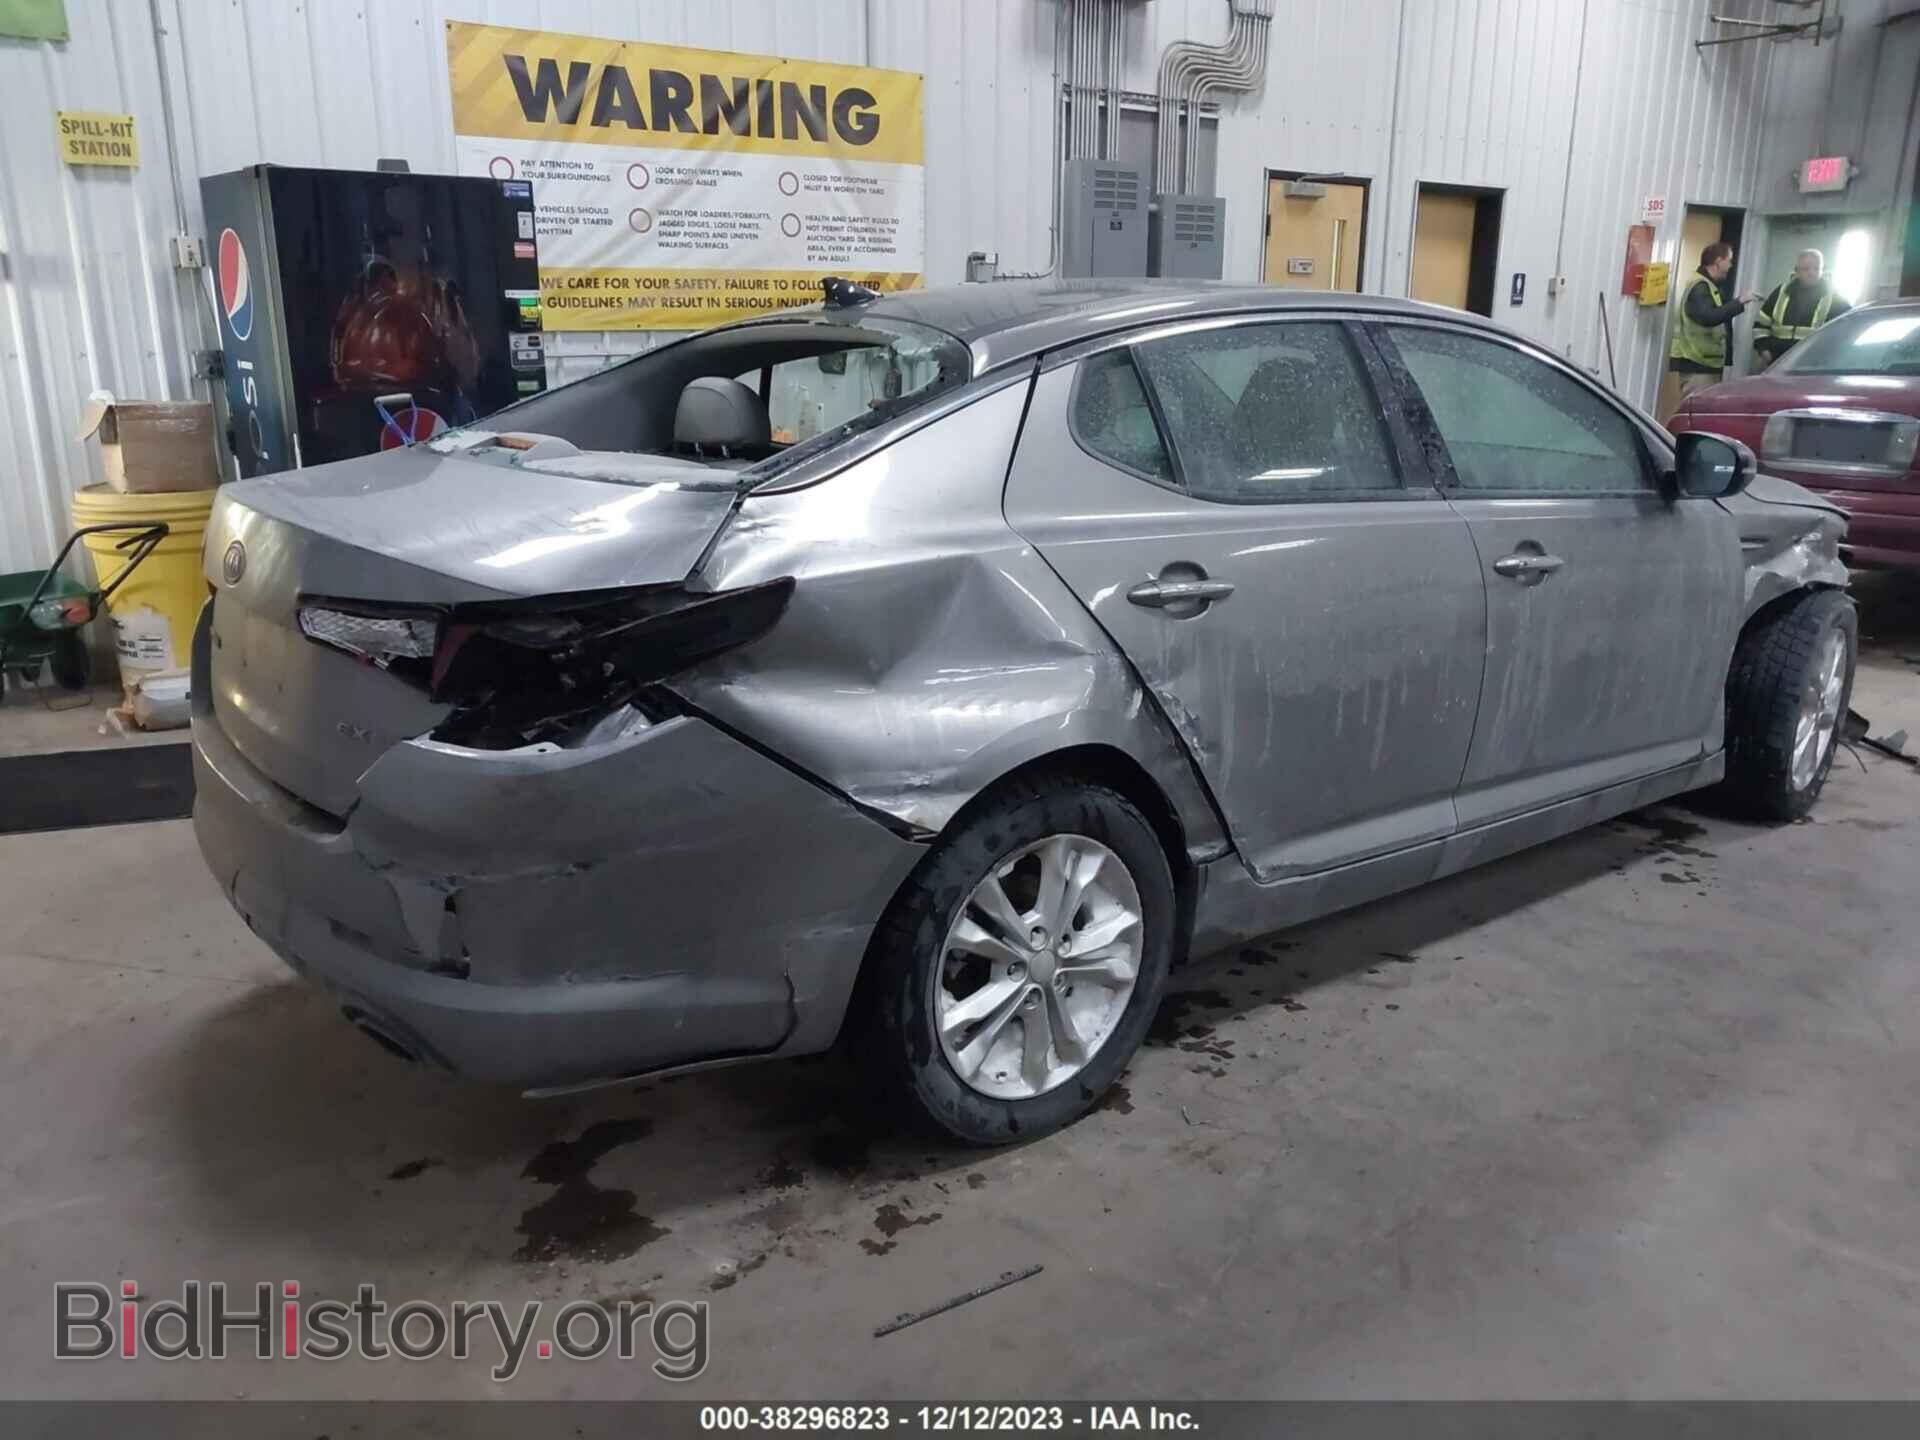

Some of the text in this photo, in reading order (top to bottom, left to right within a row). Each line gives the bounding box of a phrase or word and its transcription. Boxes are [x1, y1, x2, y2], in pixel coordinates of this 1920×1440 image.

[504, 54, 880, 146] WARNING
[61, 119, 133, 138] SPILL-KIT
[70, 139, 131, 157] STATION
[540, 161, 581, 169] ATTENTION
[584, 162, 594, 170] TO
[522, 171, 611, 182] YOUR SURROUNDINGS
[699, 168, 719, 176] WAYS
[721, 169, 743, 177] WHEN
[803, 174, 828, 182] CLOSED
[844, 176, 878, 185] FOOTWEAR
[539, 206, 576, 214] VEHICLES
[577, 206, 609, 214] SHOULD
[1648, 200, 1664, 211] SDS
[658, 209, 683, 217] WATCH
[685, 209, 698, 217] FOR
[536, 216, 565, 225] DRIVEN
[583, 217, 614, 226] STARTED
[714, 221, 737, 229] LOOSE
[658, 230, 681, 238] SHARP
[712, 231, 728, 239] AND
[730, 232, 759, 240] UNEVEN
[695, 241, 729, 249] SURFACES
[541, 277, 563, 289] WE
[567, 277, 600, 289] CARE
[604, 278, 629, 289] FOR
[634, 278, 669, 289] YOUR
[674, 278, 721, 290] SAFETY.
[725, 279, 769, 290] FAILURE
[773, 280, 788, 290] TO
[791, 280, 825, 290] FOLLO
[547, 297, 623, 308] GUIDELINES
[628, 297, 656, 308] MAY
[662, 297, 702, 308] RESULT
[706, 297, 720, 308] IN
[725, 297, 774, 308] SERIOUS
[777, 298, 815, 308] INJURY
